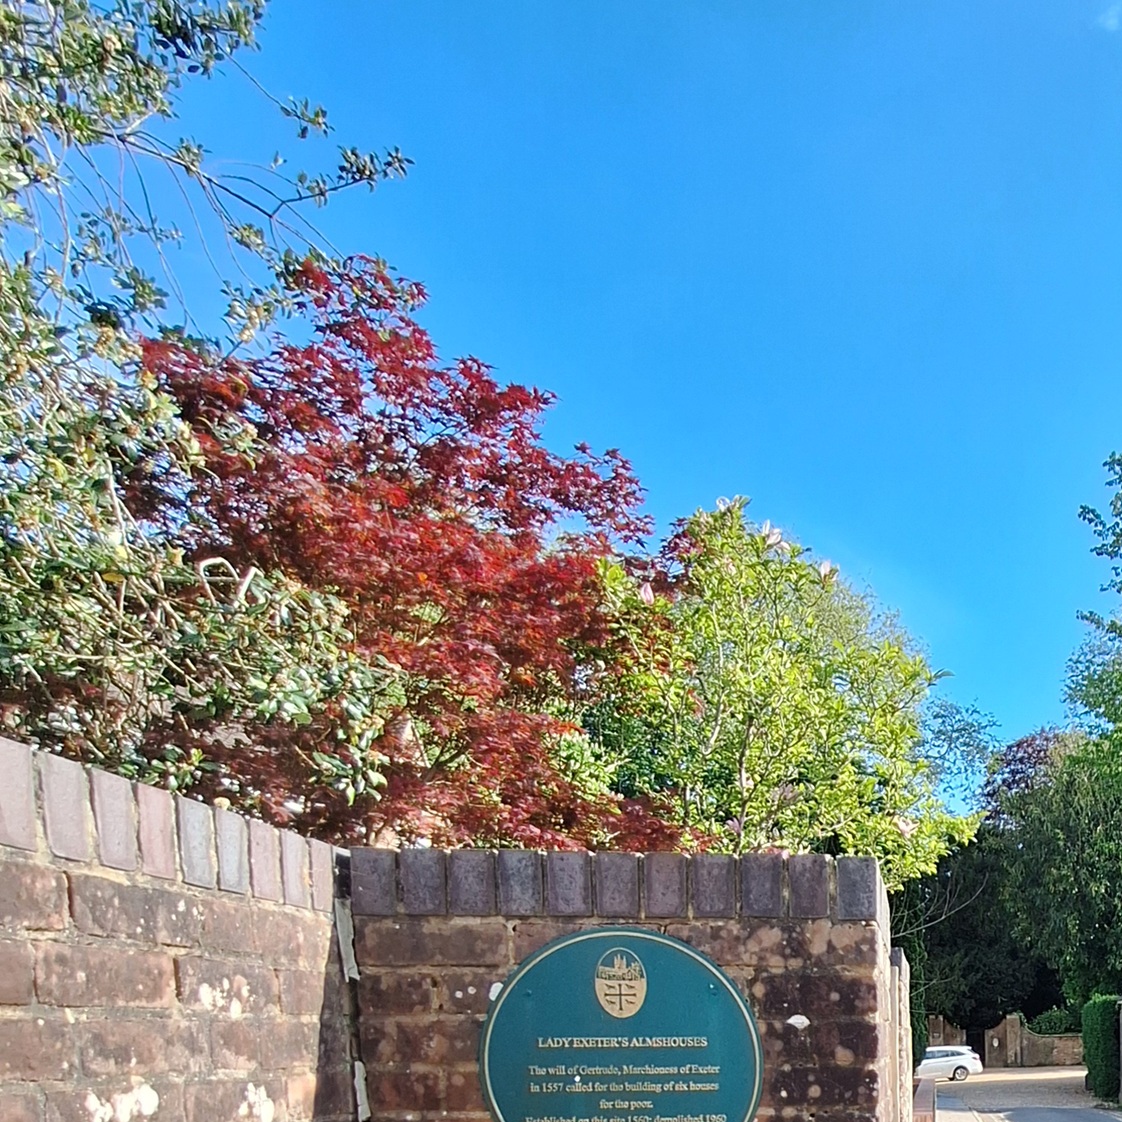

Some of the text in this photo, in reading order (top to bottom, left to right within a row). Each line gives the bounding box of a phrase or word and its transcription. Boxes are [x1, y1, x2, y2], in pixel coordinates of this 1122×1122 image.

[537, 1036, 708, 1048] LADY EXETER'S ALMSHOUSES
[528, 1064, 720, 1076] The will of Gertrude, Marchioness of Exeter
[530, 1081, 720, 1093] in 1557 called for the building of six houses
[599, 1099, 614, 1109] for
[614, 1099, 629, 1109] the
